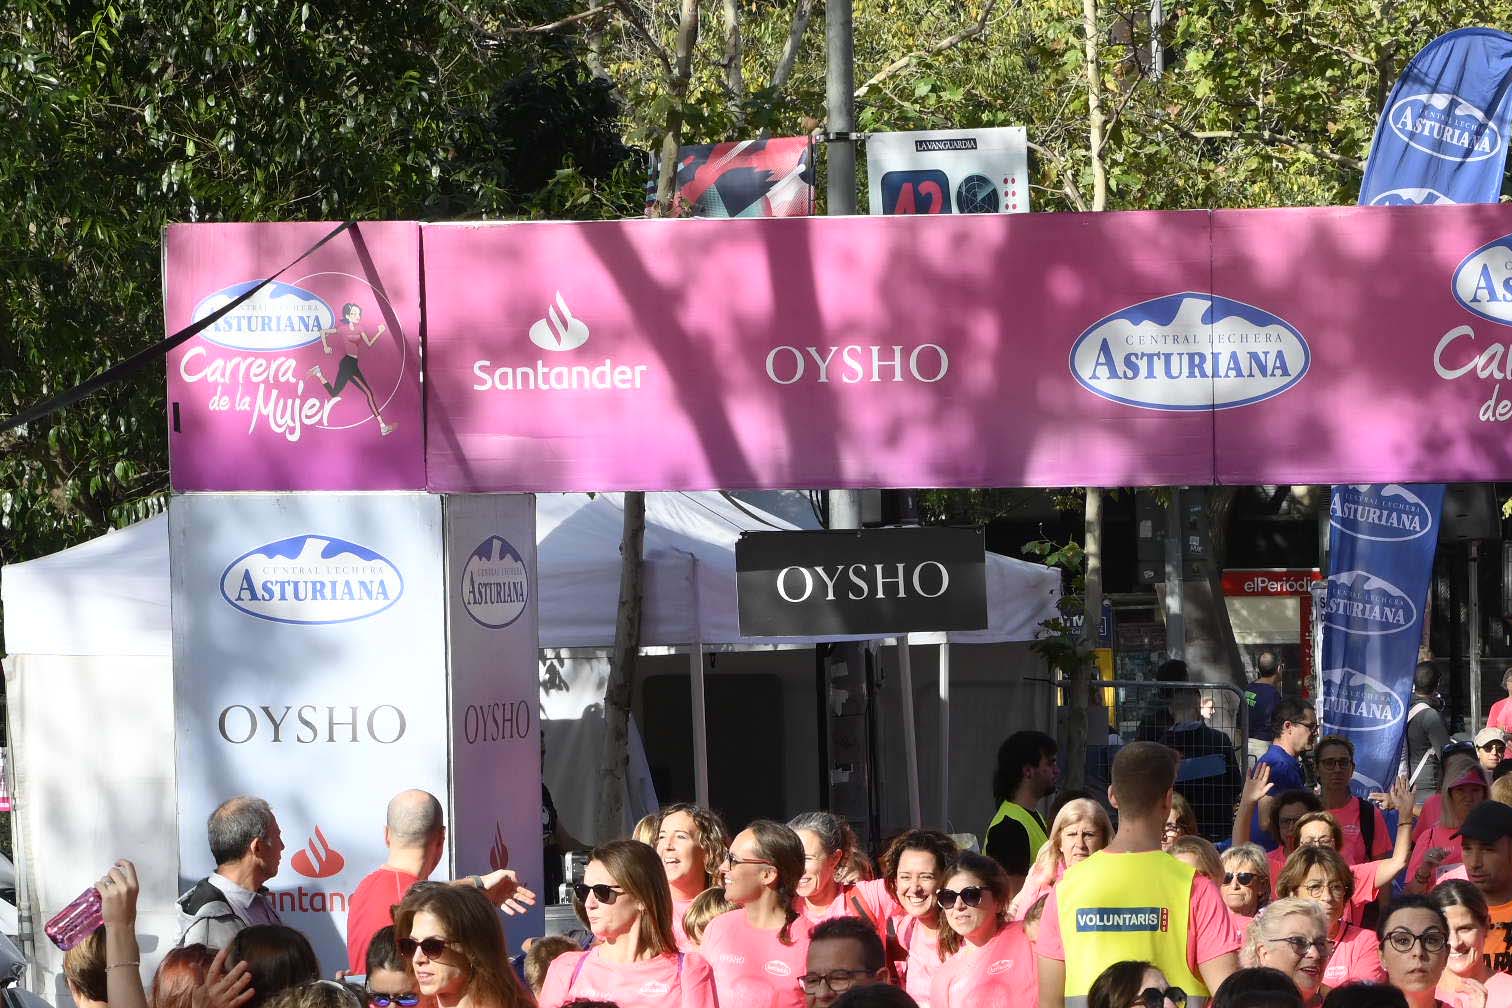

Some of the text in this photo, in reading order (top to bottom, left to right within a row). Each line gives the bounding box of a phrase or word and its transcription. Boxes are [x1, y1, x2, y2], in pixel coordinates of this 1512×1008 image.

[929, 140, 977, 150] VANGUARDIA
[1397, 108, 1491, 153] ASTURIANA
[1126, 332, 1283, 346] CENTRAL LECHERA
[180, 346, 297, 384] Carrera
[473, 360, 647, 391] Santander
[766, 343, 949, 384] OYSHO
[1089, 338, 1291, 380] ASTURIANA
[209, 380, 342, 442] de la Mujer
[1480, 384, 1512, 421] de
[1330, 493, 1420, 531] ASTURIANA
[236, 569, 389, 601] ASTURIANA
[263, 567, 321, 575] CENTRAL
[467, 571, 524, 606] ASTURIANA
[776, 561, 949, 602] OYSHO
[1244, 577, 1318, 594] elPeriódi
[1326, 598, 1405, 625] STURIANA
[218, 705, 406, 743] OYSHO
[465, 701, 530, 744] OYSHO
[267, 887, 352, 912] antan
[1078, 913, 1158, 927] VOLUNTARIS
